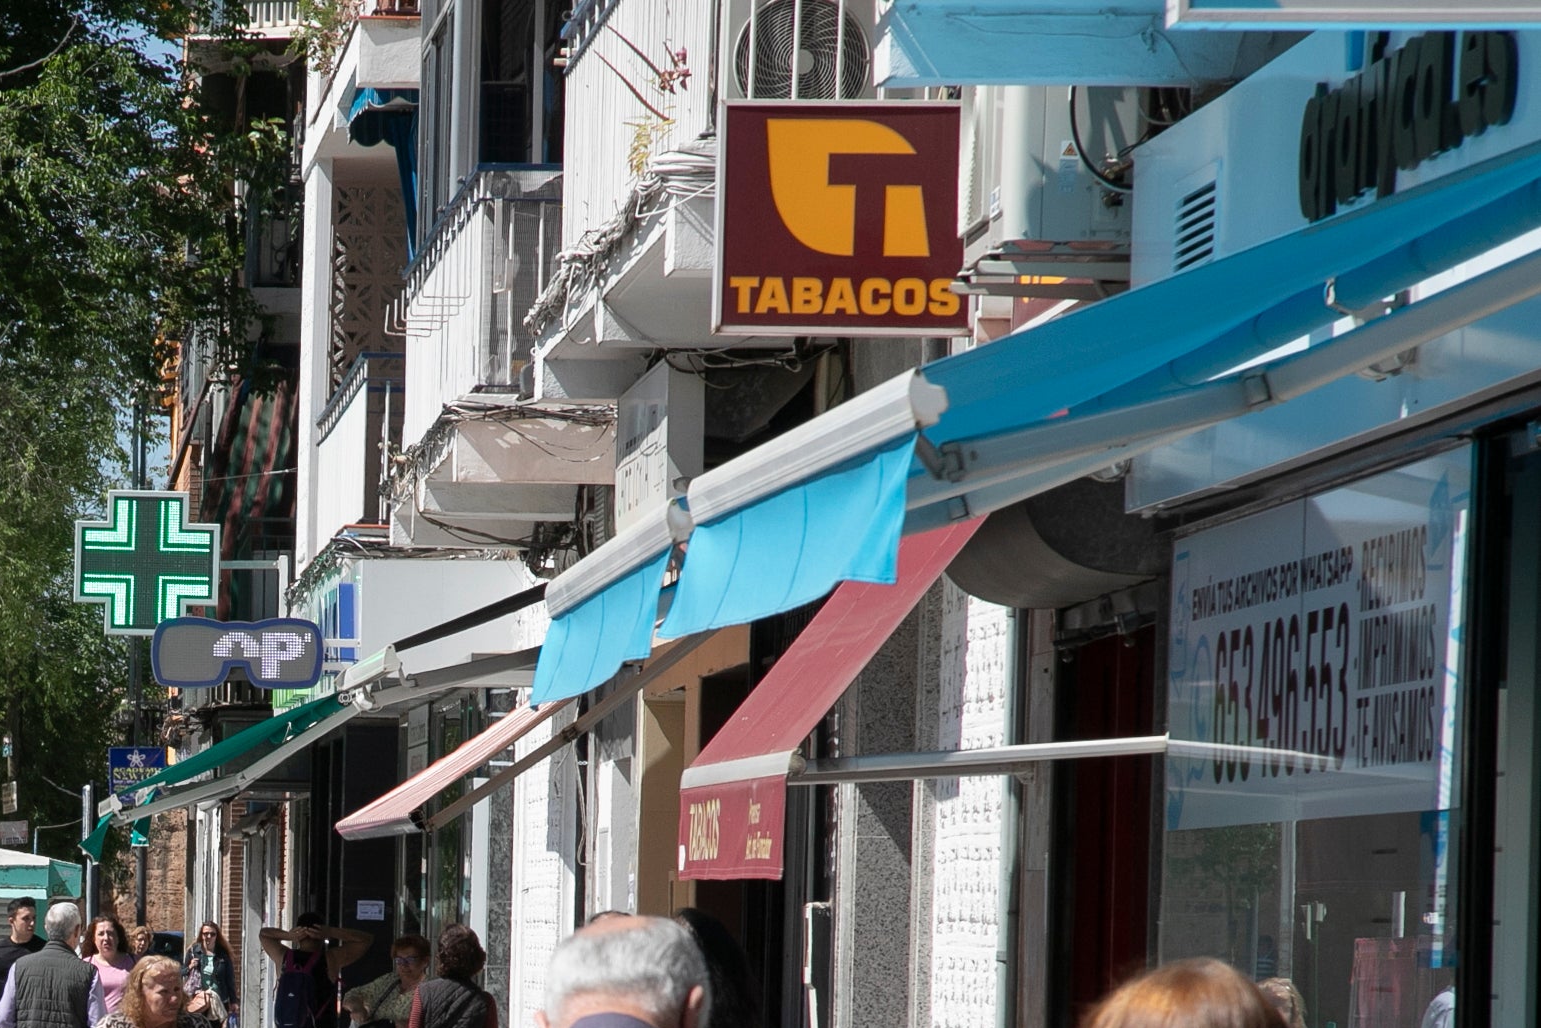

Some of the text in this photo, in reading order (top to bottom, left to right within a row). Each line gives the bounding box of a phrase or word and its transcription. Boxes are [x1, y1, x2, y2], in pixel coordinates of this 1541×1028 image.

[729, 276, 961, 317] TABACOS
[1192, 545, 1354, 621] ENVÍA TUS ARCHIVOS POR WHATSAPP
[1213, 602, 1349, 785] 653 496 553
[689, 799, 721, 861] TABACOS
